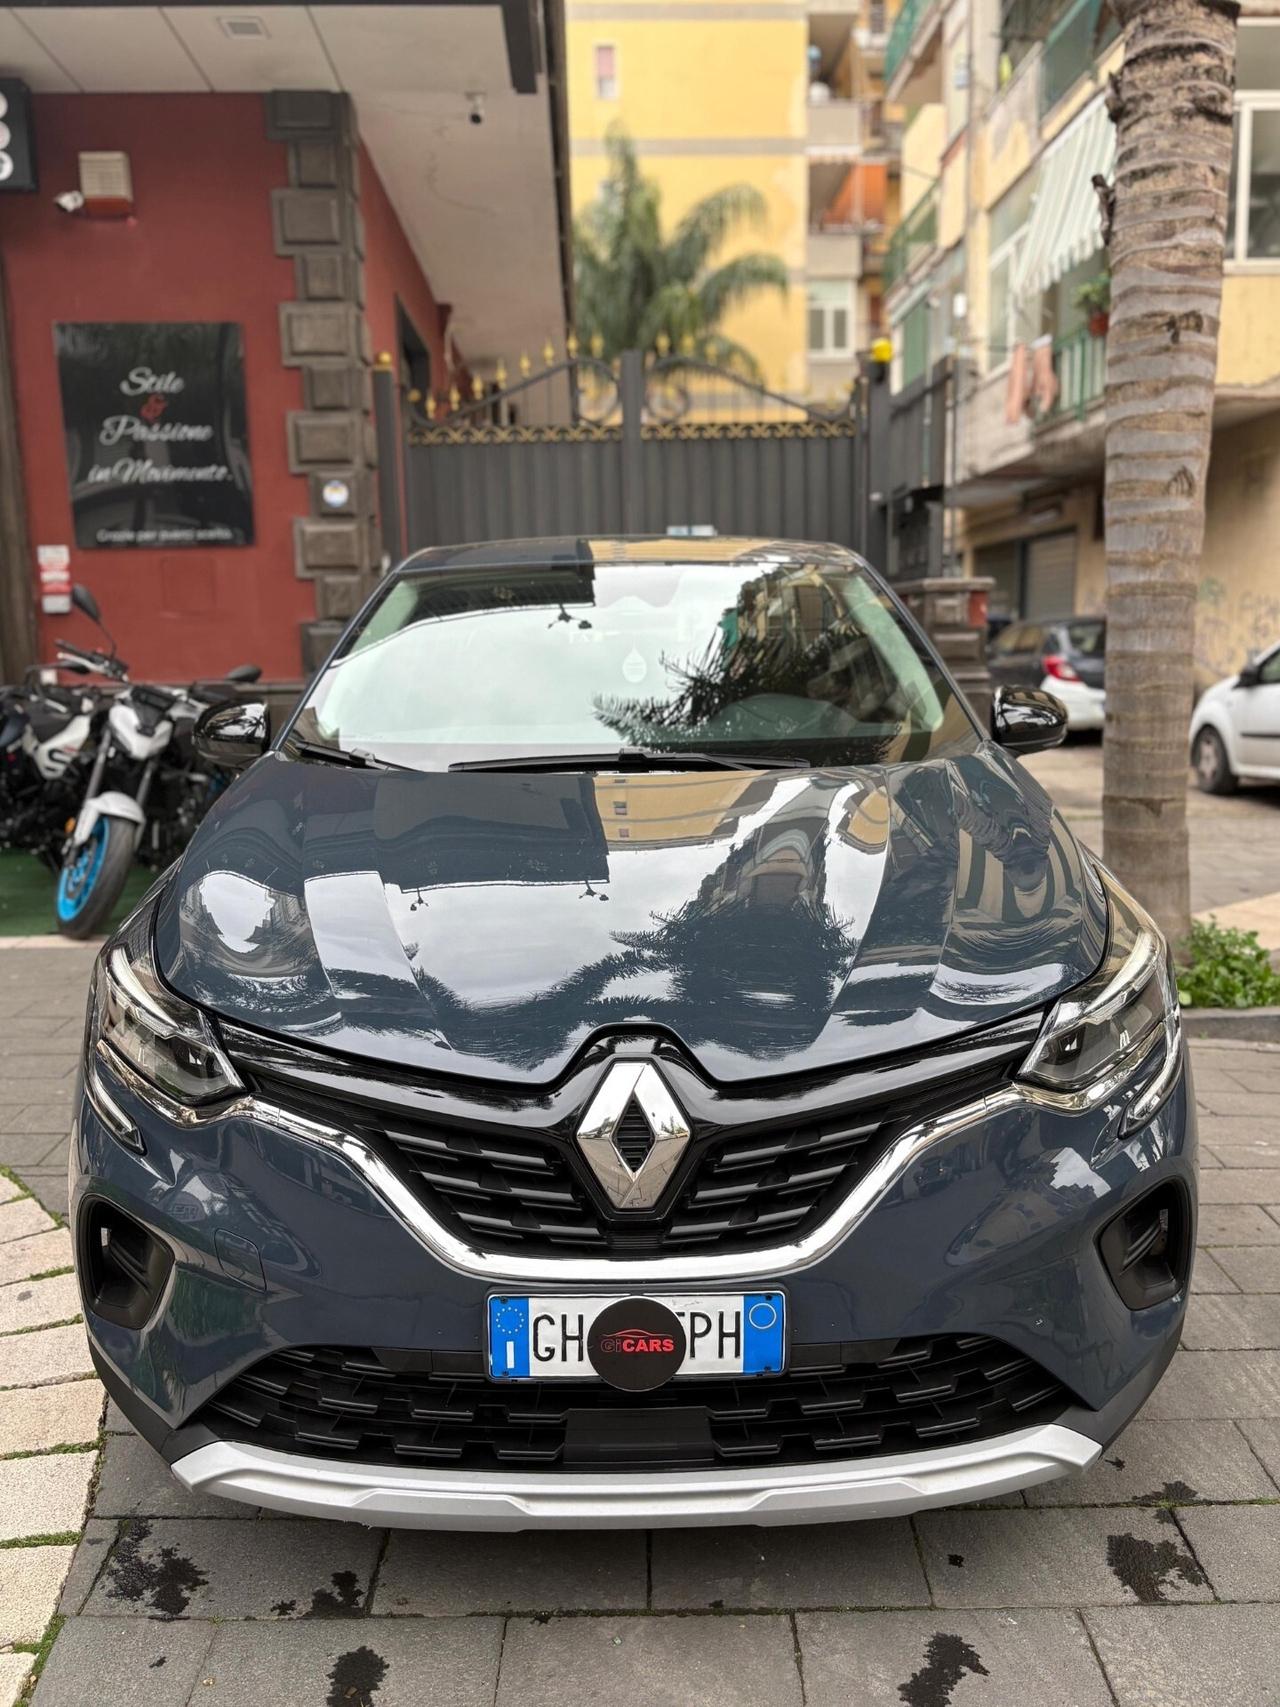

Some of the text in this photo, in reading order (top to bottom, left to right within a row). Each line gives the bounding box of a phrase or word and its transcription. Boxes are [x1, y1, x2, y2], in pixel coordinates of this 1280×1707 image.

[120, 366, 184, 396] Stile
[99, 414, 213, 446] Passione
[88, 464, 112, 483] in
[533, 1314, 584, 1362] GH
[675, 1311, 741, 1359] PH
